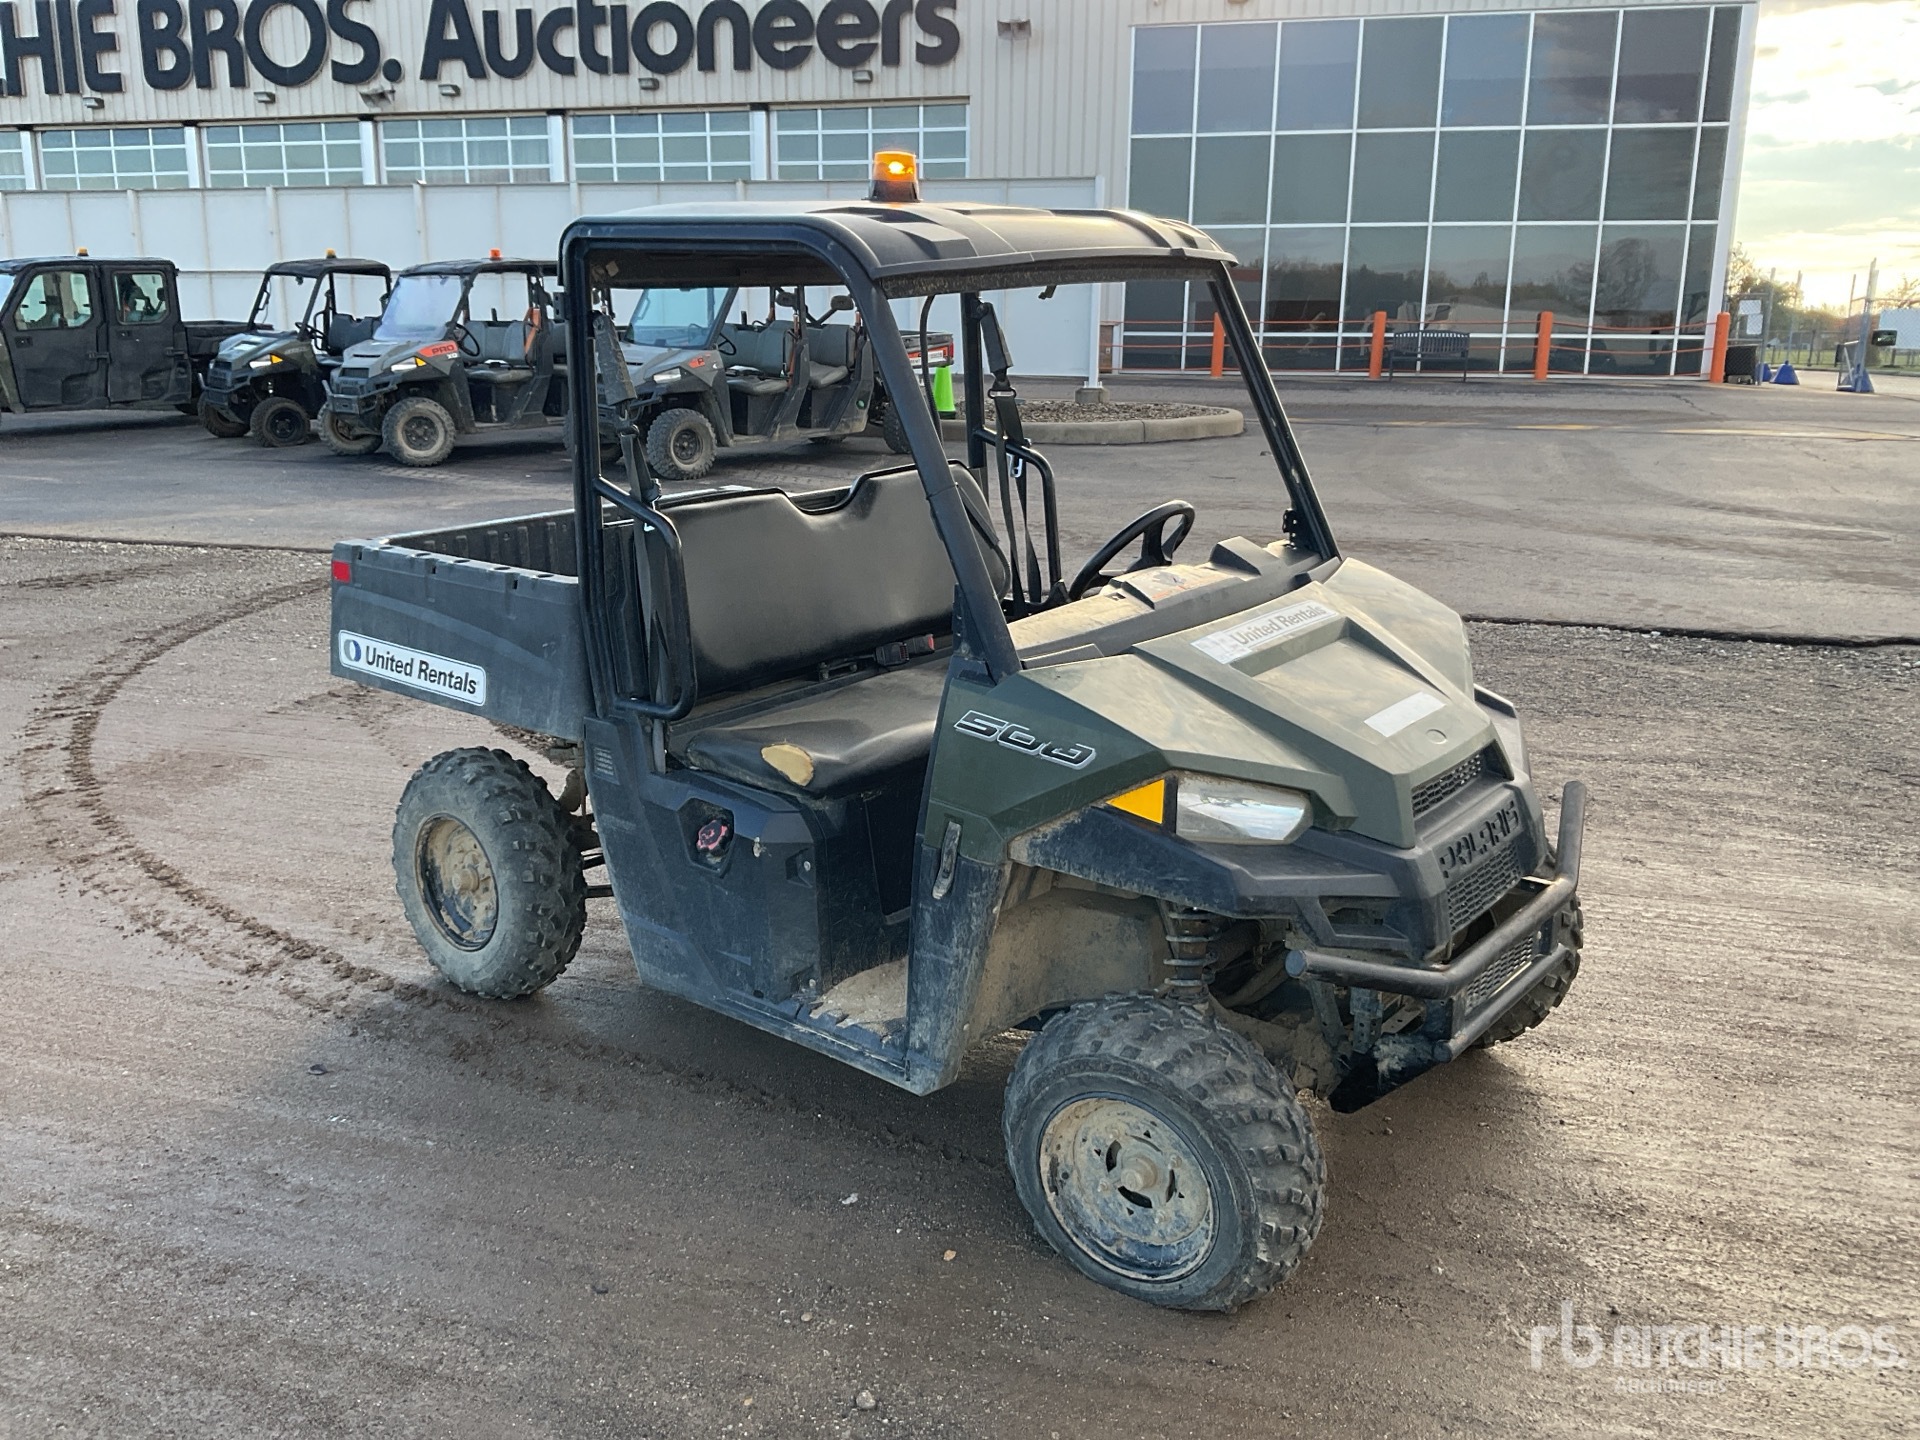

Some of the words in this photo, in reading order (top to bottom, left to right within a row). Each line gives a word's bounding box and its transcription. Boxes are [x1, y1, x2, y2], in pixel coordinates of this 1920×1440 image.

[0, 0, 124, 97] HIE
[137, 0, 402, 91] BROS.
[420, 0, 960, 81] Auctioneers
[431, 344, 455, 356] PRO
[1231, 618, 1282, 645] United
[1275, 604, 1327, 628] Rentals
[366, 645, 414, 677] United
[418, 660, 478, 695] Rentals
[953, 709, 1097, 770] 500
[1440, 800, 1520, 879] POLARIS
